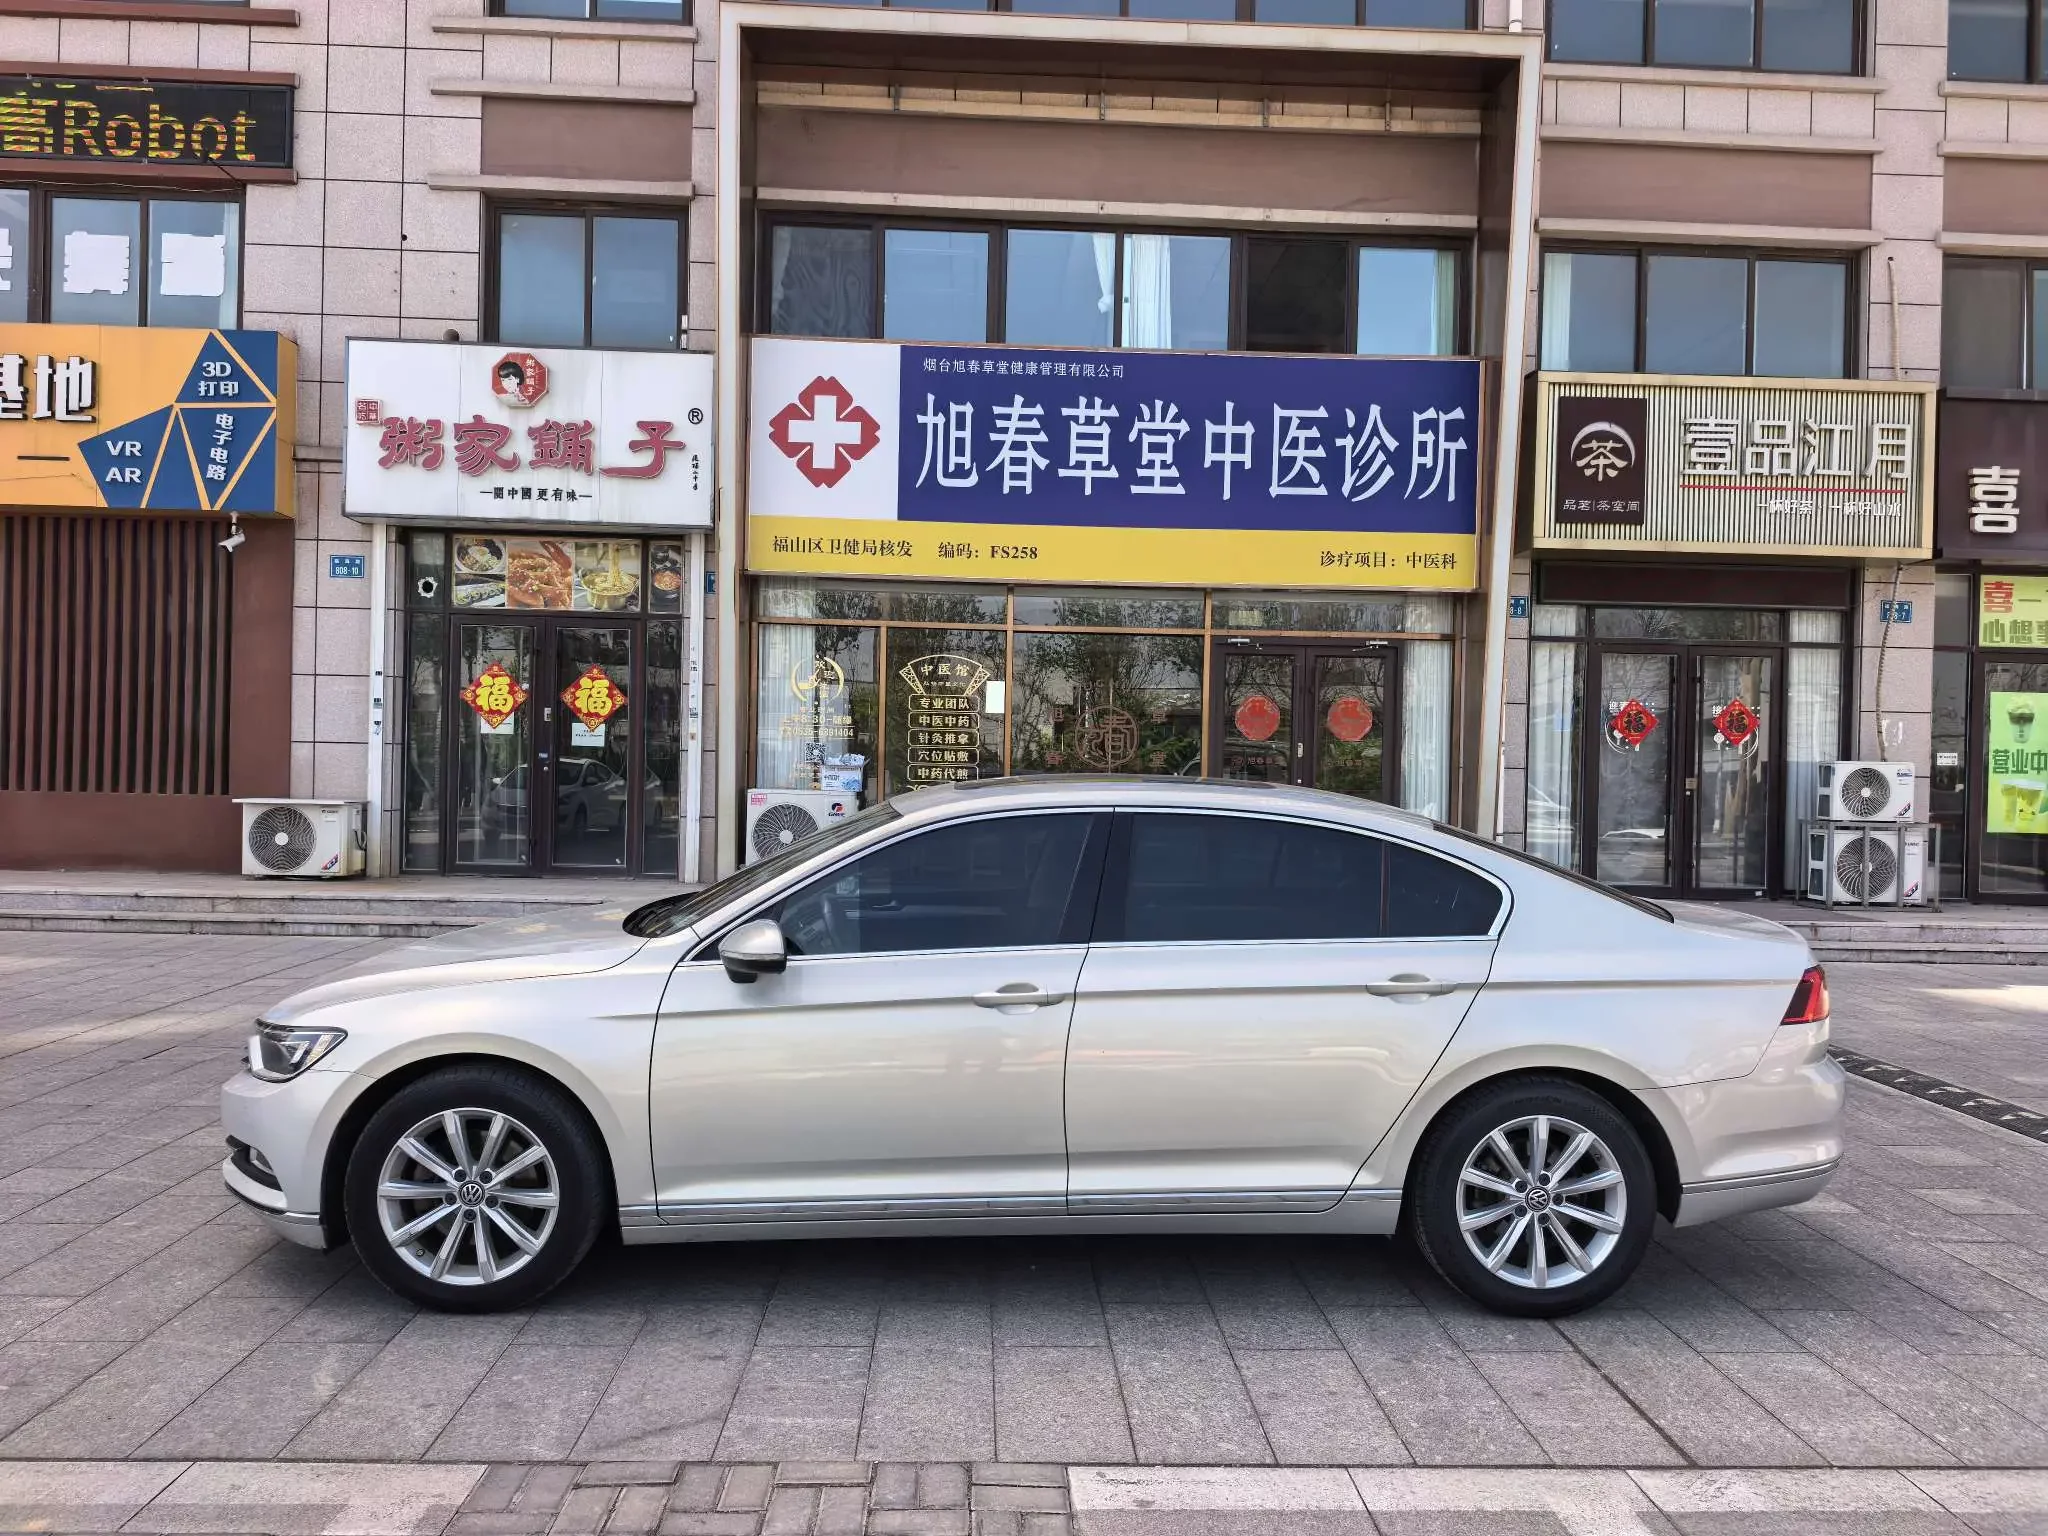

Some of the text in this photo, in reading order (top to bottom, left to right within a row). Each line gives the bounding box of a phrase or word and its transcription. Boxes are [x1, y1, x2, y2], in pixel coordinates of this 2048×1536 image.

[202, 361, 232, 378] 3D
[923, 357, 1125, 379] 烟台旭春草堂健康管理有限公司
[198, 380, 239, 397] 打印
[106, 440, 143, 457] VR
[206, 413, 235, 481] 电子电路
[914, 391, 1468, 503] 旭春草堂中医诊所
[1680, 416, 1911, 479] 壹品江月
[1576, 439, 1629, 482] 茶
[105, 467, 143, 484] AR
[1967, 465, 2020, 533] 喜
[772, 535, 913, 559] 福山区卫健局核发
[1319, 550, 1457, 571] 诊疗项目：中医科
[335, 566, 359, 576] 808-10
[920, 663, 969, 677] 中医馆
[475, 674, 513, 713] 福
[575, 677, 613, 716] 福
[919, 698, 970, 710] 专业团队
[919, 715, 970, 728] 中医中药
[918, 732, 969, 745] 针灸推拿
[918, 750, 969, 763] 穴位贴敷
[1992, 748, 2048, 775] 营业中
[918, 767, 969, 780] 中药代煎
